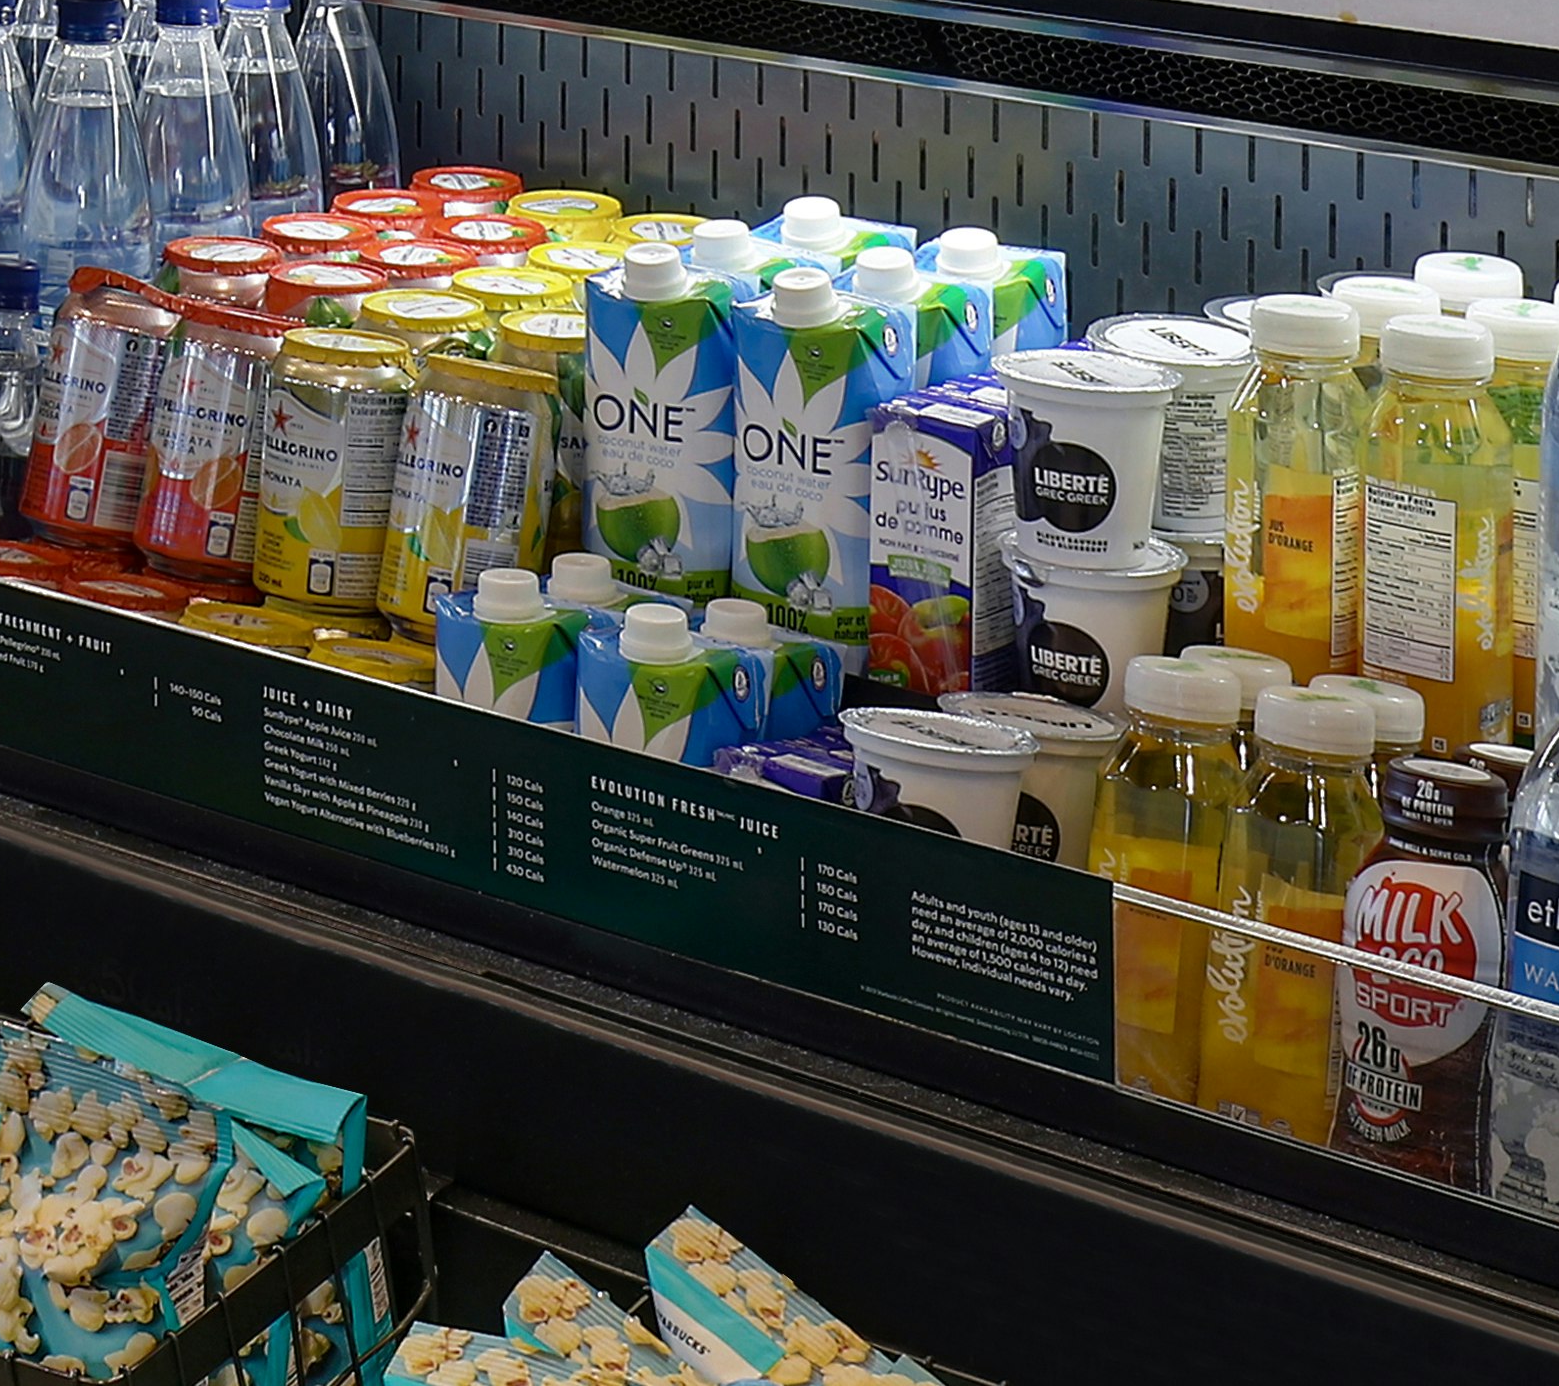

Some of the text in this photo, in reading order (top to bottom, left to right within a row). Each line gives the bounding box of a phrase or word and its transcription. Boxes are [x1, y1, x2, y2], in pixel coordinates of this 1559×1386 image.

[593, 394, 683, 443] ONE
[744, 422, 831, 475] ONE
[1034, 467, 1109, 494] LIBERTÉ
[1035, 484, 1108, 506] GREC GREEK
[79, 636, 112, 655] FRUIT
[1031, 646, 1102, 673] LIBERTÉ
[263, 685, 353, 721] JUICE DAIRY
[591, 776, 665, 808] EVOLUTION
[740, 817, 779, 839] JUICE
[1356, 887, 1462, 945] MILK
[1356, 983, 1454, 1026] SPORT
[1358, 1021, 1400, 1073] 26g
[1360, 1071, 1419, 1107] PROTEIN
